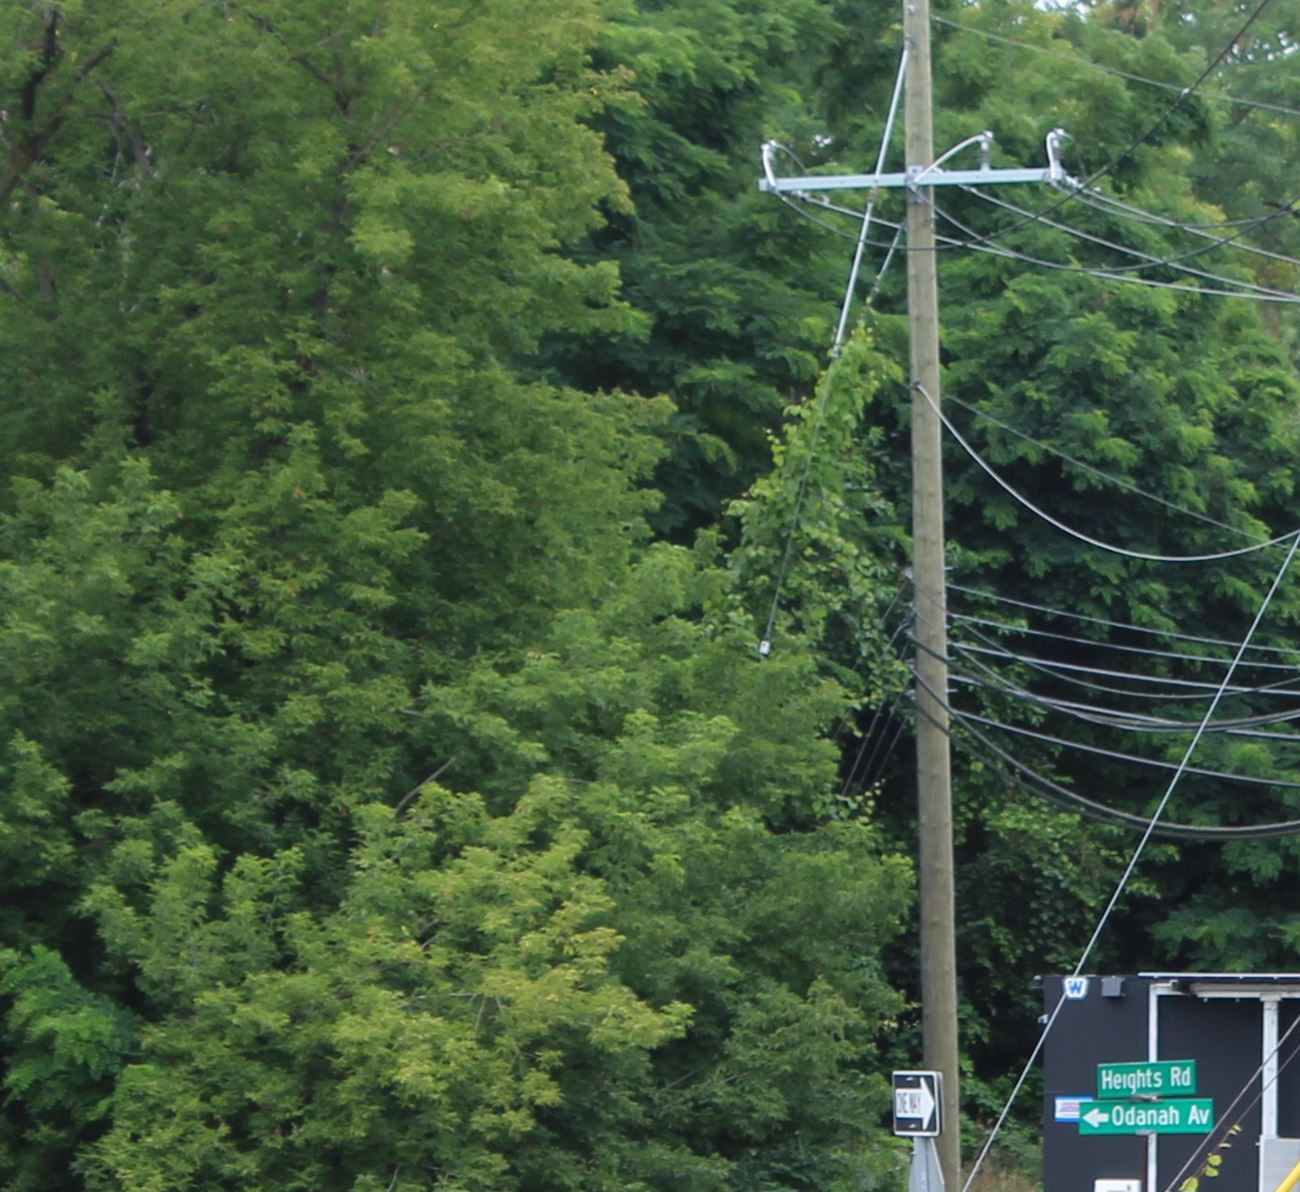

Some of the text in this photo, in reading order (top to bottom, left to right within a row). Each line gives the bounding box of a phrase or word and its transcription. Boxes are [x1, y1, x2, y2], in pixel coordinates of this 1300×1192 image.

[1101, 1066, 1191, 1094] Heights Rd
[1111, 1105, 1211, 1126] Odanah Av
